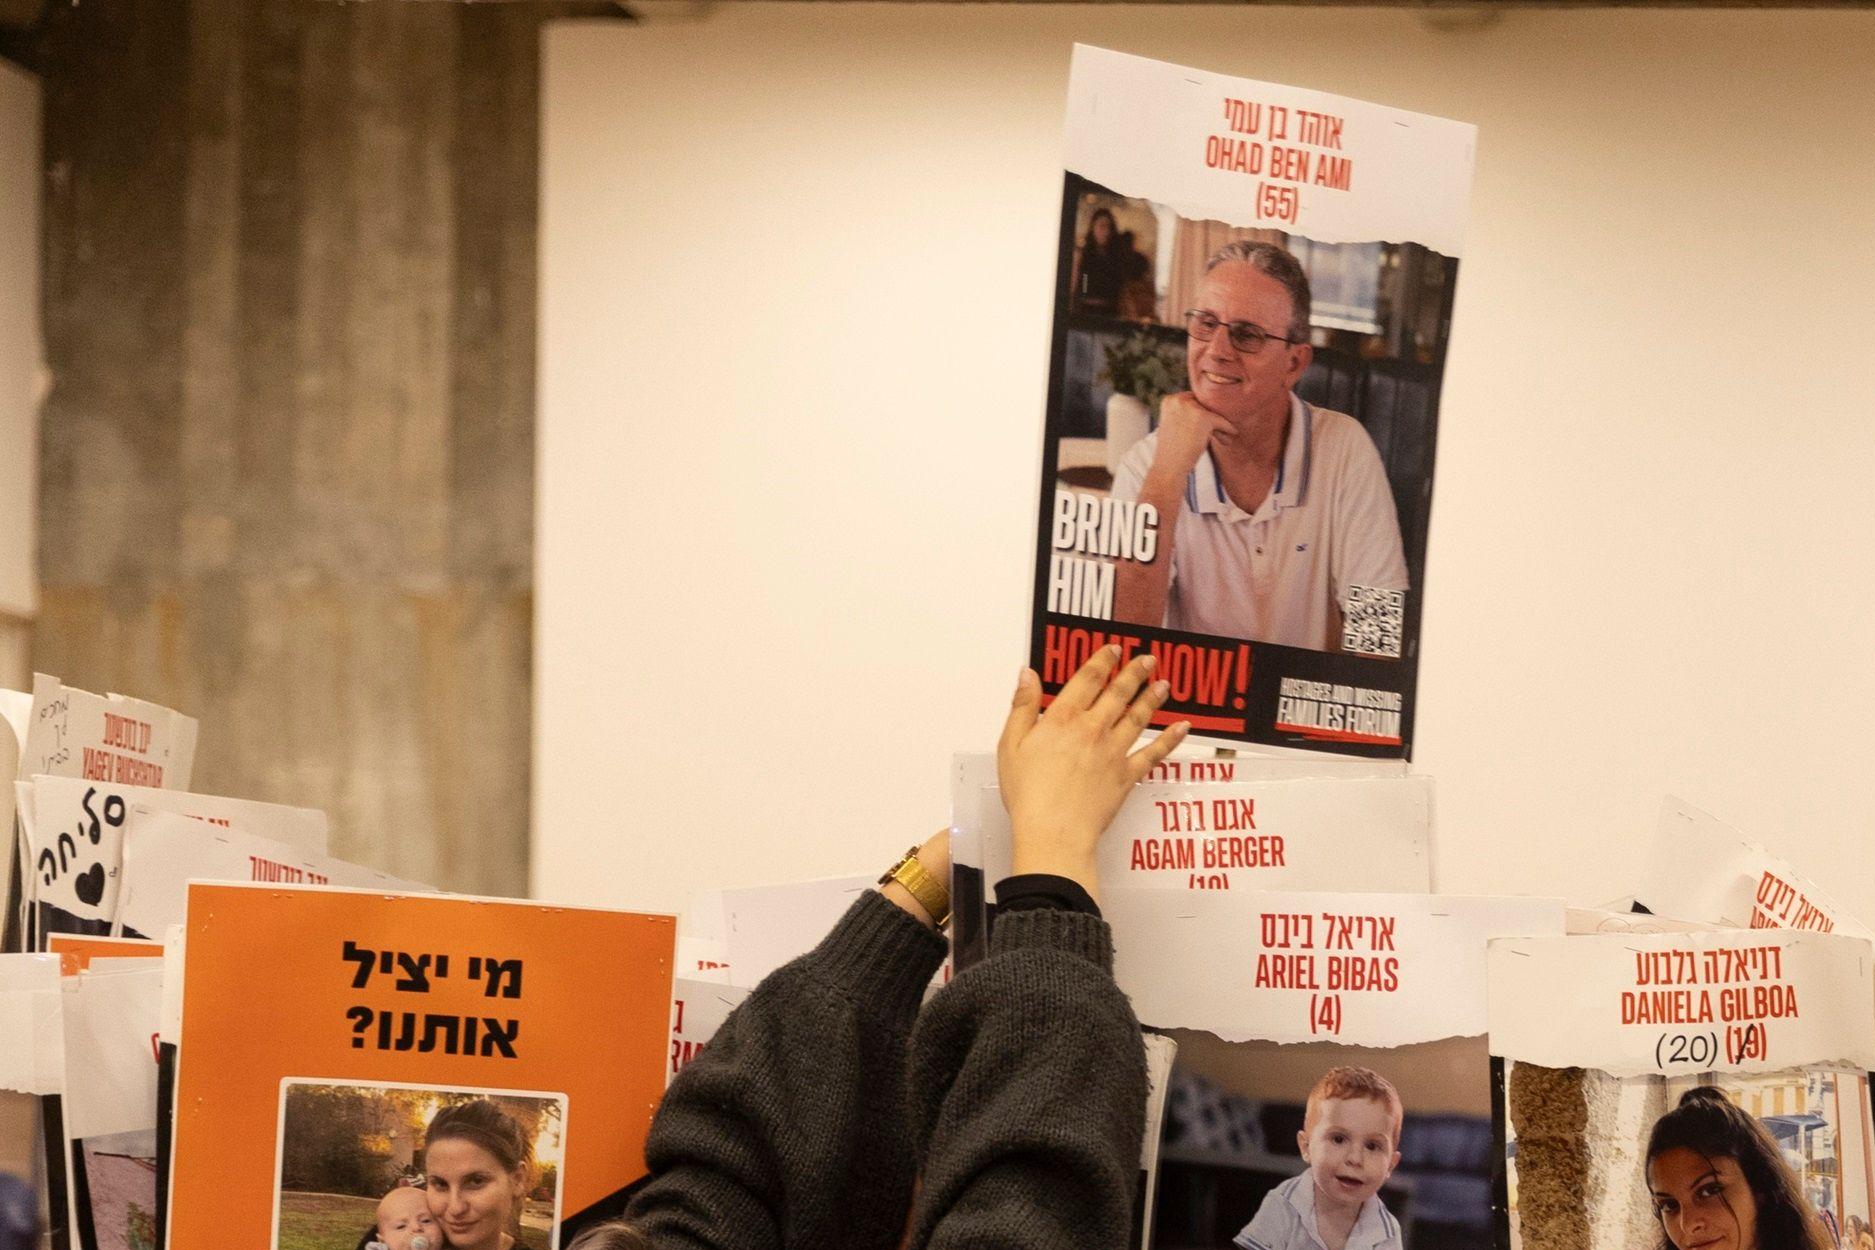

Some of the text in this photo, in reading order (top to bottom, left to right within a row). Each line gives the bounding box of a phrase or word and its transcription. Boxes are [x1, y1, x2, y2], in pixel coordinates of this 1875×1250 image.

[1223, 97, 1345, 151] אוהד בן עמי
[1205, 134, 1354, 192] OHAD BEN AMI
[1255, 180, 1300, 225] (55)
[1051, 489, 1159, 562] BRING
[1047, 553, 1116, 621] HIM
[1150, 637, 1251, 710] NOW!
[1276, 695, 1401, 739] FAMILIES FORUM
[1154, 798, 1257, 832] אגם ברגר
[1130, 835, 1285, 871] AGAM BERGER
[1259, 912, 1396, 952] אריאל ביבס
[341, 940, 523, 999] מי יציל
[1254, 954, 1400, 993] ARIEL BIBAS
[1636, 945, 1782, 987] דניאלה גלבוע
[1310, 993, 1342, 1035] (4)
[1621, 984, 1799, 1026] DANIELA GILBOA
[345, 1005, 519, 1059] אותנו?
[1655, 1031, 1719, 1069] (20)
